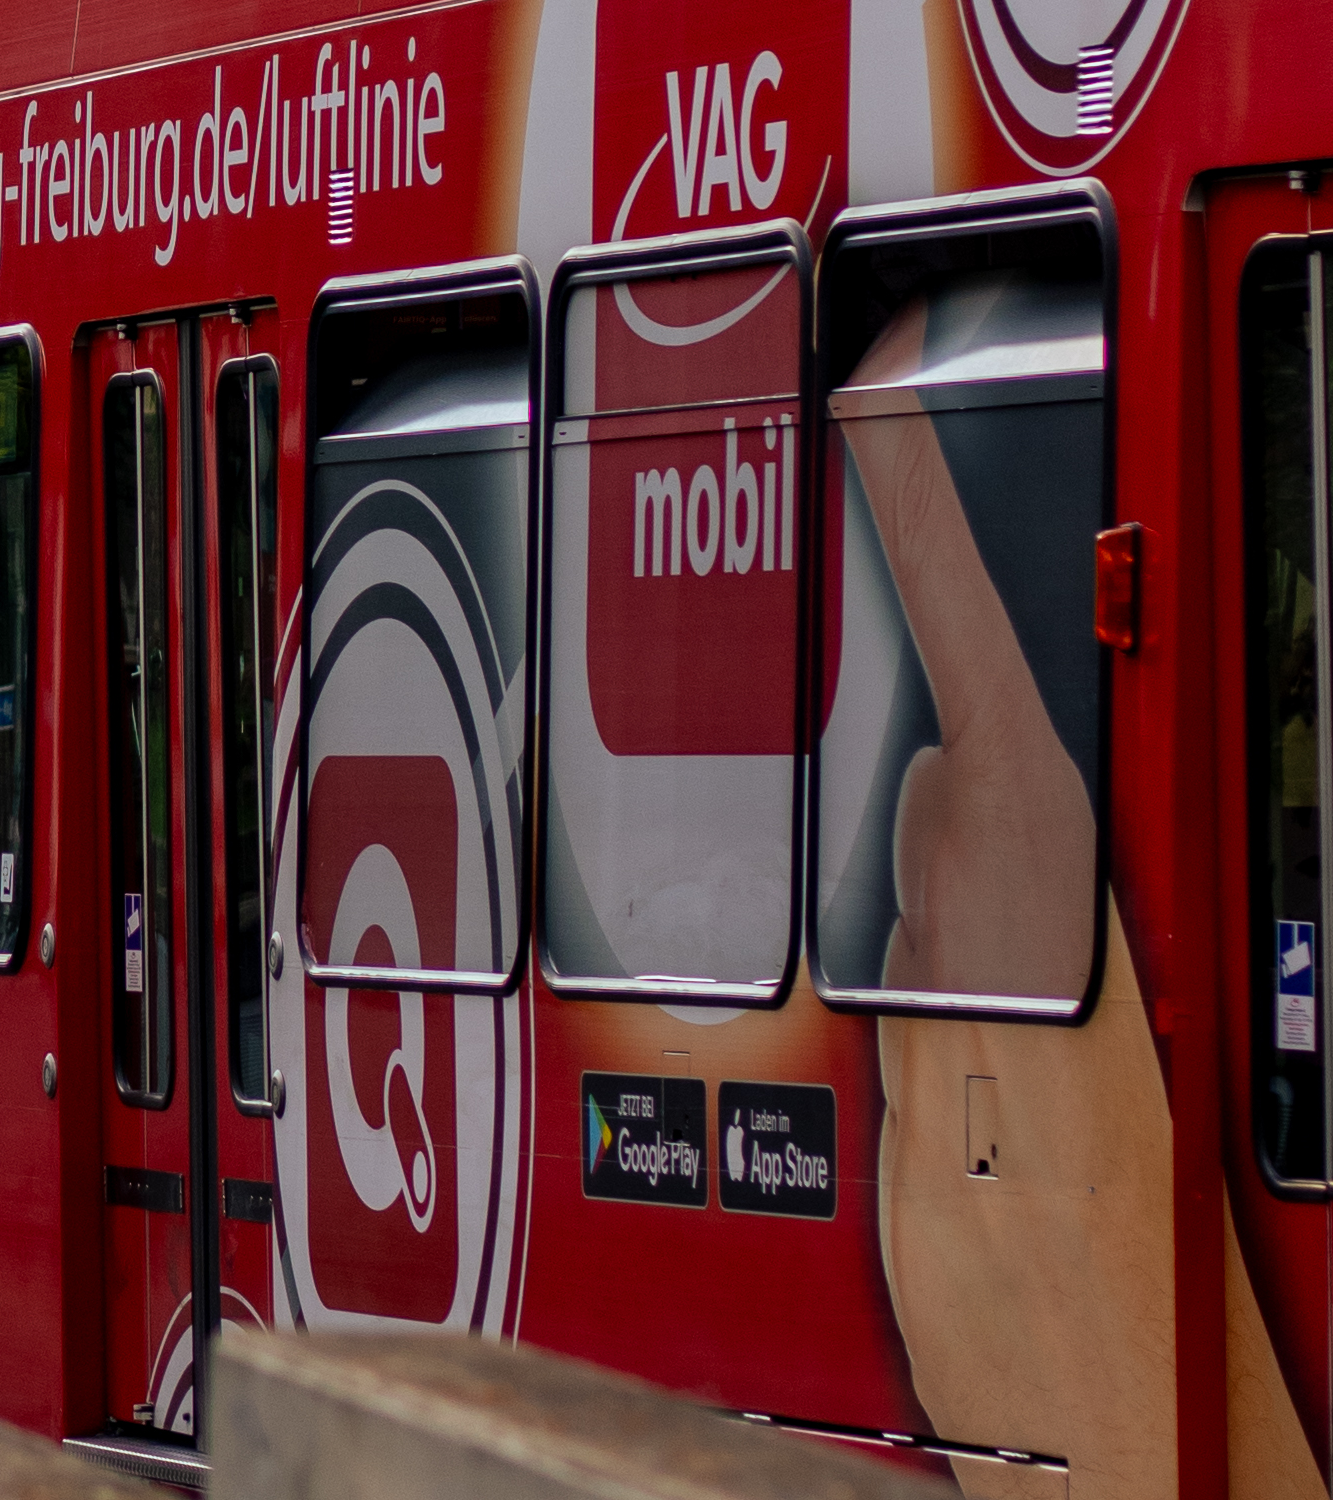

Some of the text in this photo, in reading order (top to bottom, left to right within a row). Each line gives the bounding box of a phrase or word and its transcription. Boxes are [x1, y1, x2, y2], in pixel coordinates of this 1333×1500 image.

[665, 49, 788, 220] VAG
[633, 412, 795, 579] mobil
[617, 1094, 655, 1118] JETZT BEI
[750, 1109, 790, 1133] Laden im
[617, 1126, 700, 1189] Google Play
[749, 1140, 829, 1196] App Store
